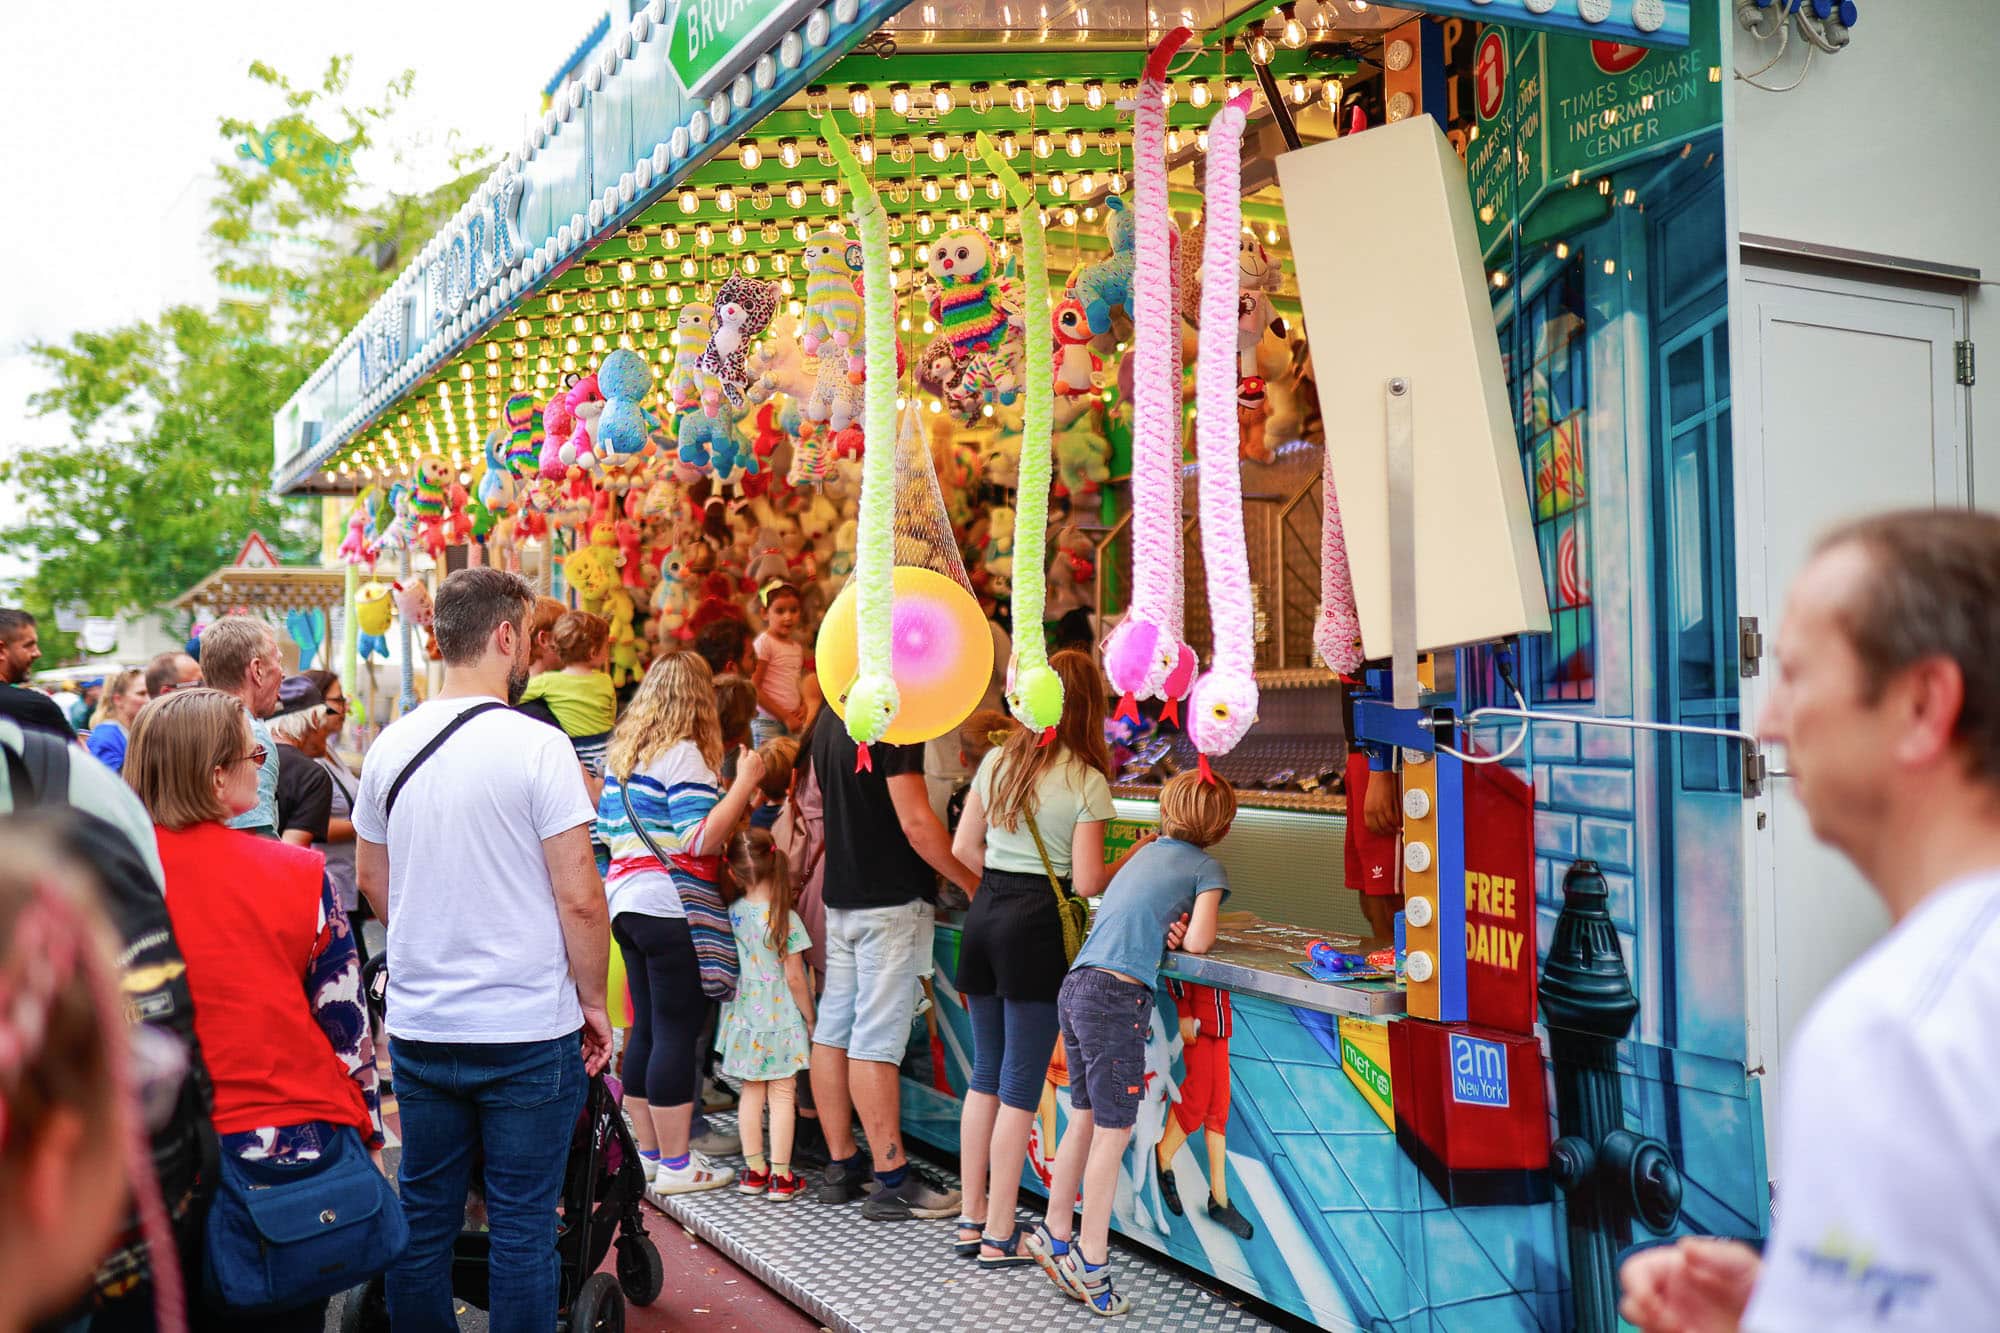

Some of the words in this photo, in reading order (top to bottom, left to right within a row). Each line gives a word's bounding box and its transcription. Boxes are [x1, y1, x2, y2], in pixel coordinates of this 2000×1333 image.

[1560, 81, 1617, 119] TIMES
[1628, 50, 1702, 96] SQUARE
[1471, 127, 1500, 182] TIMES
[1586, 117, 1660, 158] CENTER
[1465, 869, 1517, 919] FREE
[1465, 920, 1524, 971] DAILY
[1344, 1044, 1390, 1096] metro
[1456, 1039, 1502, 1080] am
[1458, 1076, 1480, 1097] New
[1479, 1077, 1504, 1100] York
